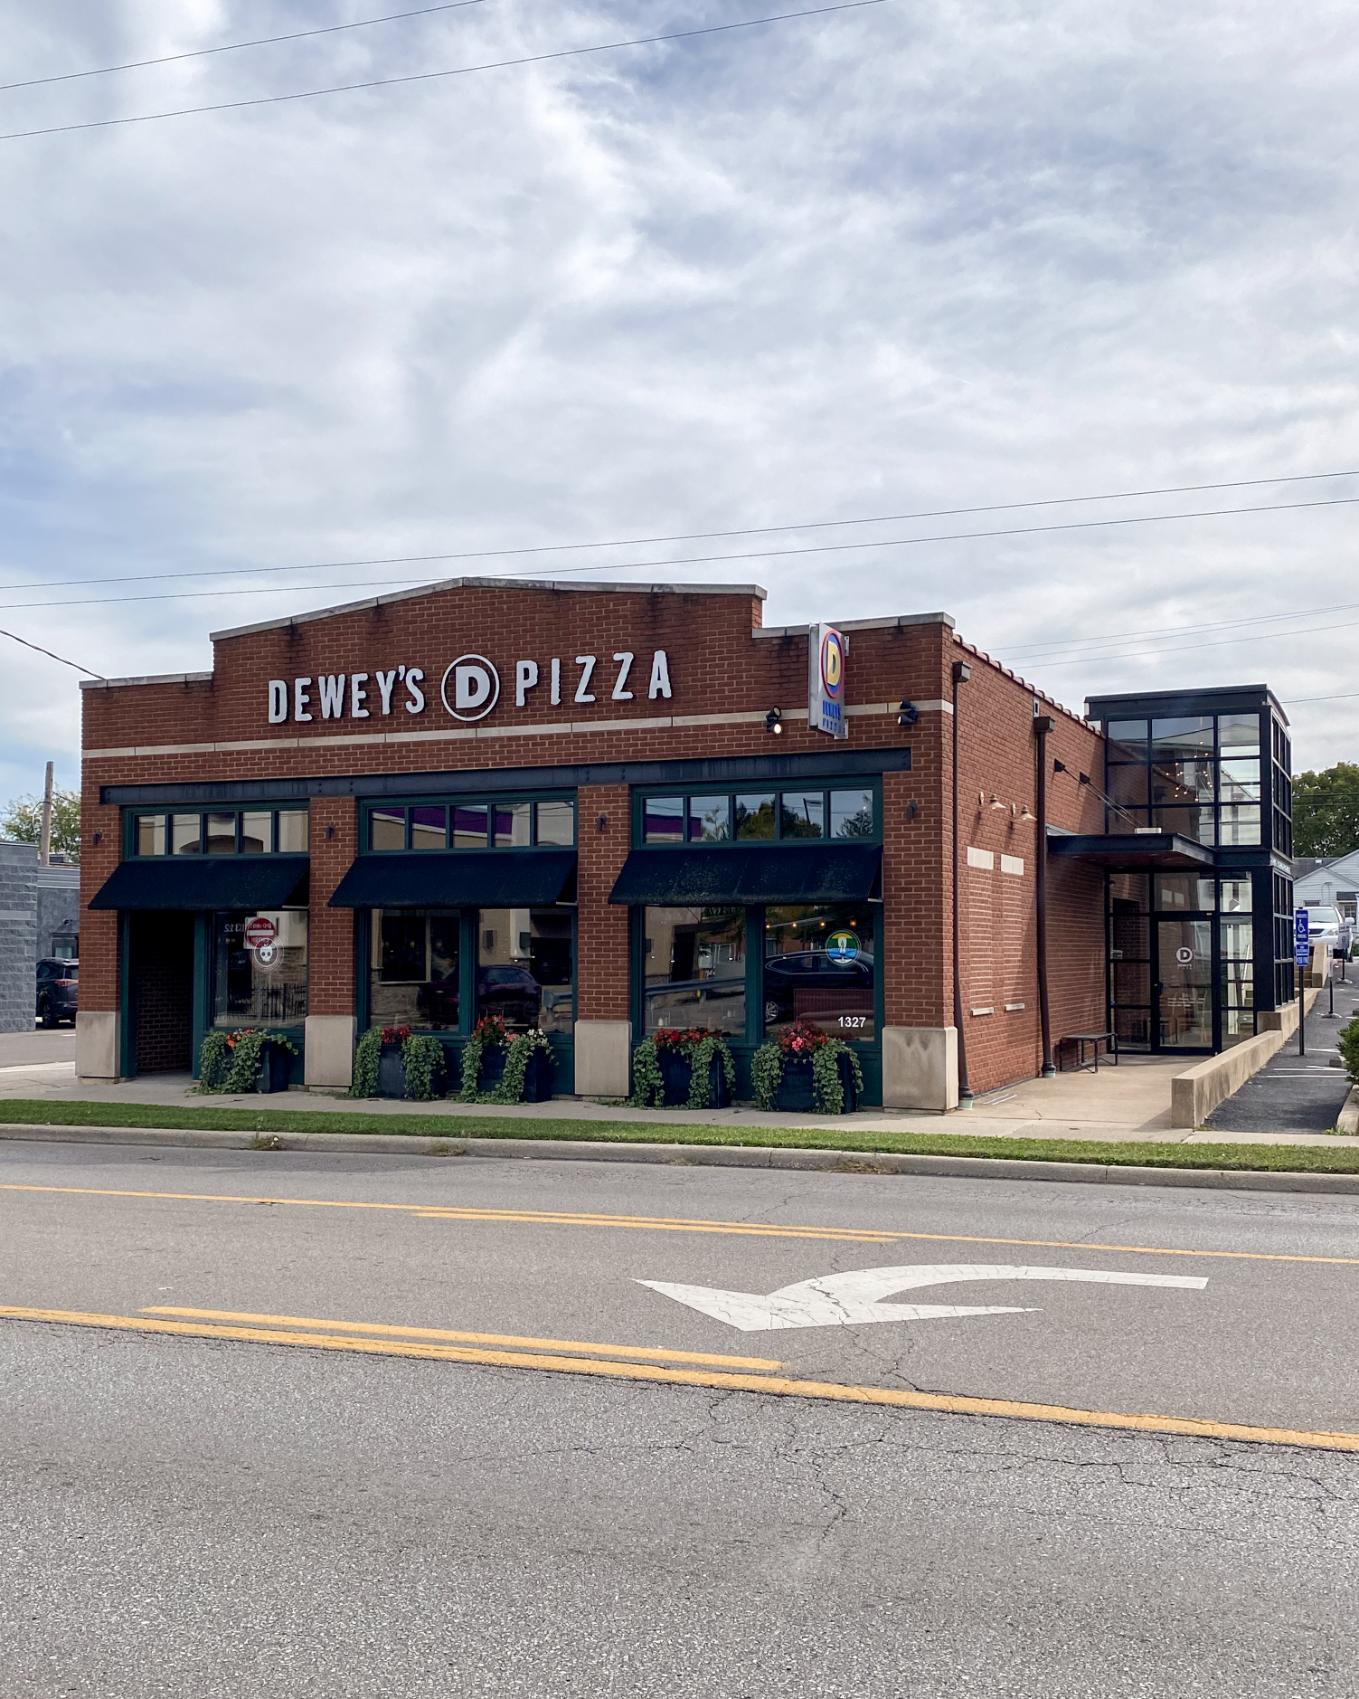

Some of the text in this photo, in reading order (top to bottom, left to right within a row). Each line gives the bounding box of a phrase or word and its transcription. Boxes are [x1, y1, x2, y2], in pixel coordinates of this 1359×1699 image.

[827, 641, 841, 686] D
[268, 650, 672, 724] DEWEY'S D PIZZA
[838, 1016, 866, 1028] 1327
